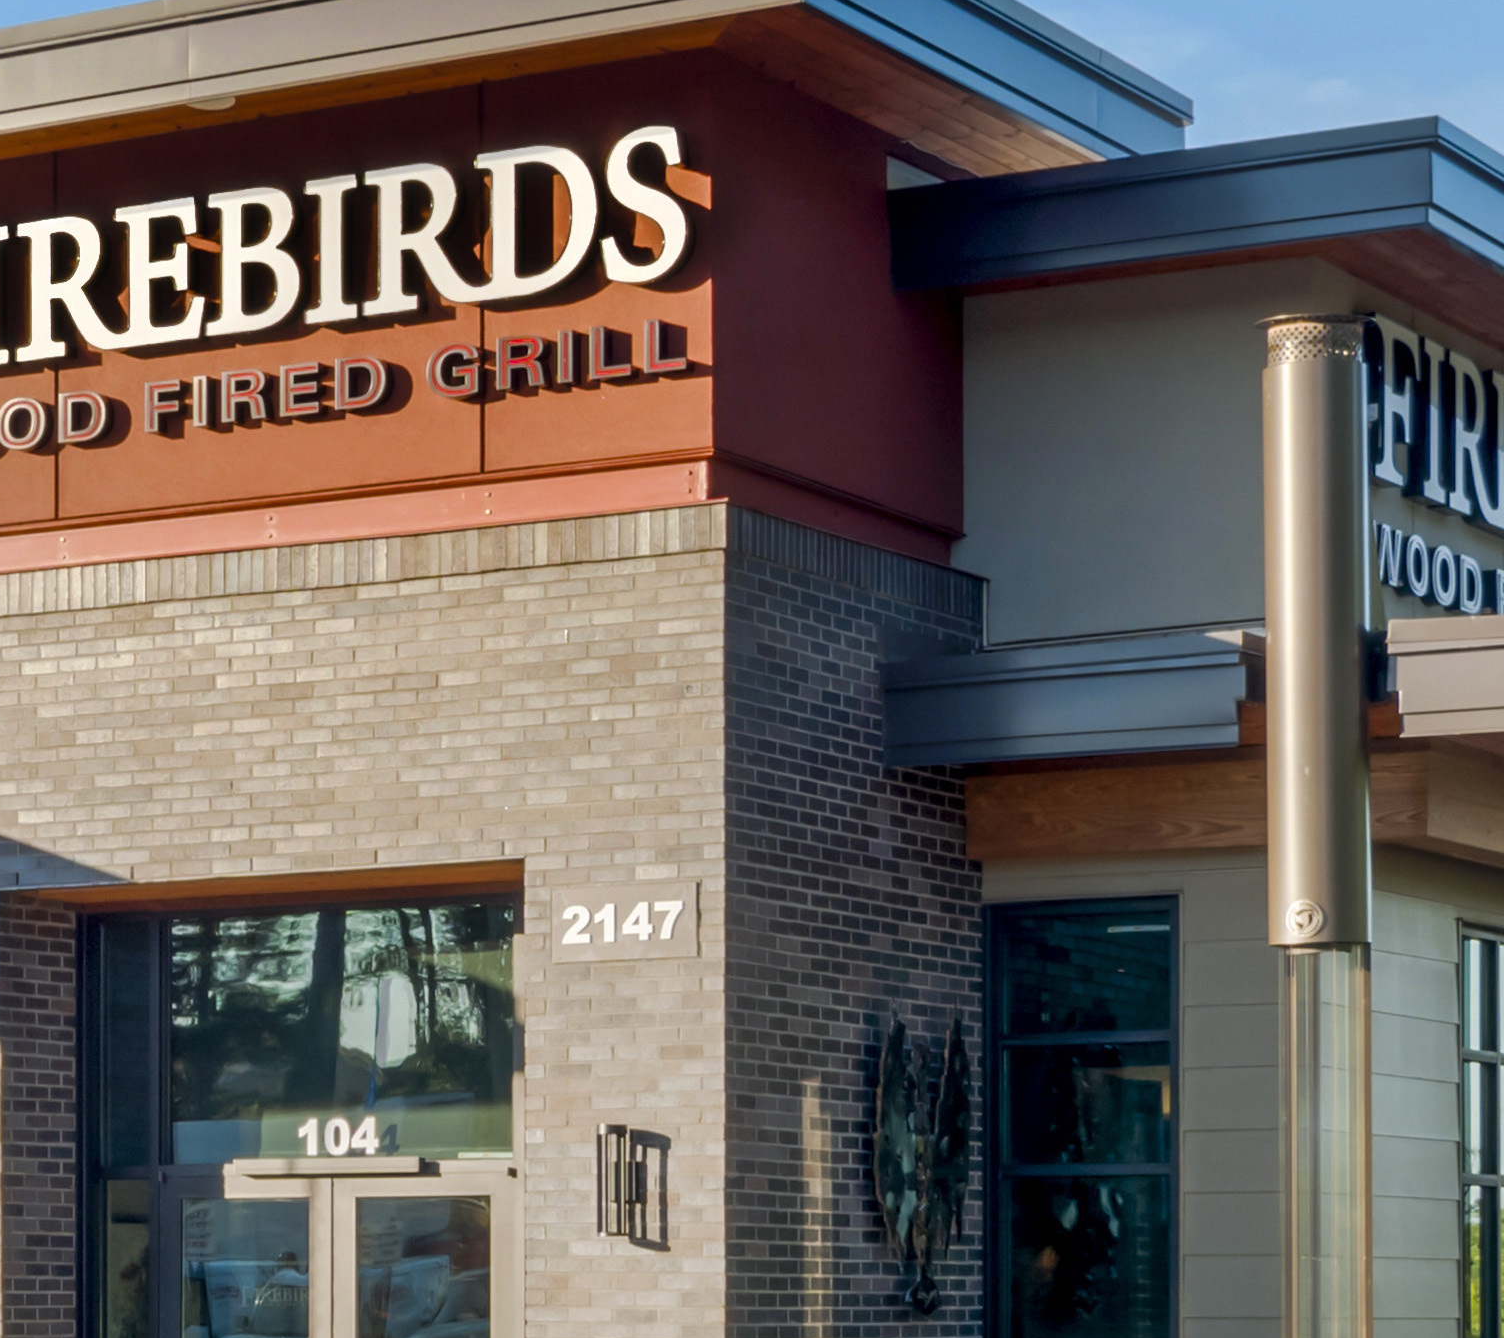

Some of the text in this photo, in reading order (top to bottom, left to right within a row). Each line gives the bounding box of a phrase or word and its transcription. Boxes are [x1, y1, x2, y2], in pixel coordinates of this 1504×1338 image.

[144, 355, 387, 433] FIRED
[426, 319, 688, 399] GRILL
[1373, 519, 1483, 614] WOOD
[561, 900, 685, 946] 2147
[298, 1116, 380, 1157] 104
